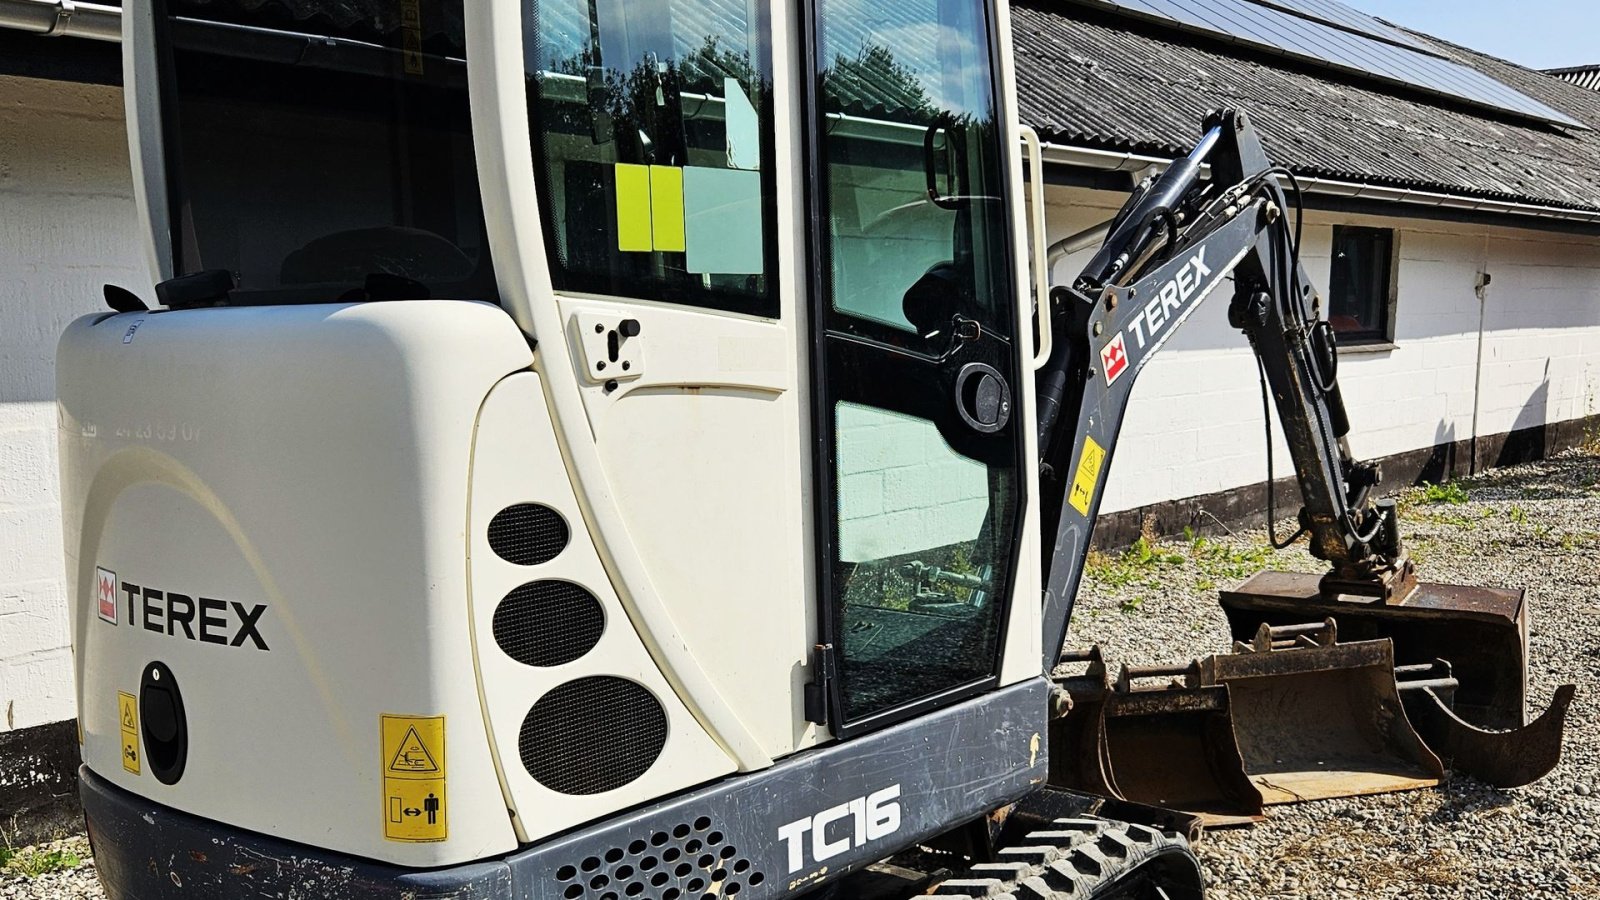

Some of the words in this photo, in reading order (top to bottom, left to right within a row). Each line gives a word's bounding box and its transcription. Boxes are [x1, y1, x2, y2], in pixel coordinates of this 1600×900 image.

[1129, 245, 1212, 349] TEREX
[121, 582, 270, 650] TEREX
[778, 783, 901, 874] TC16
